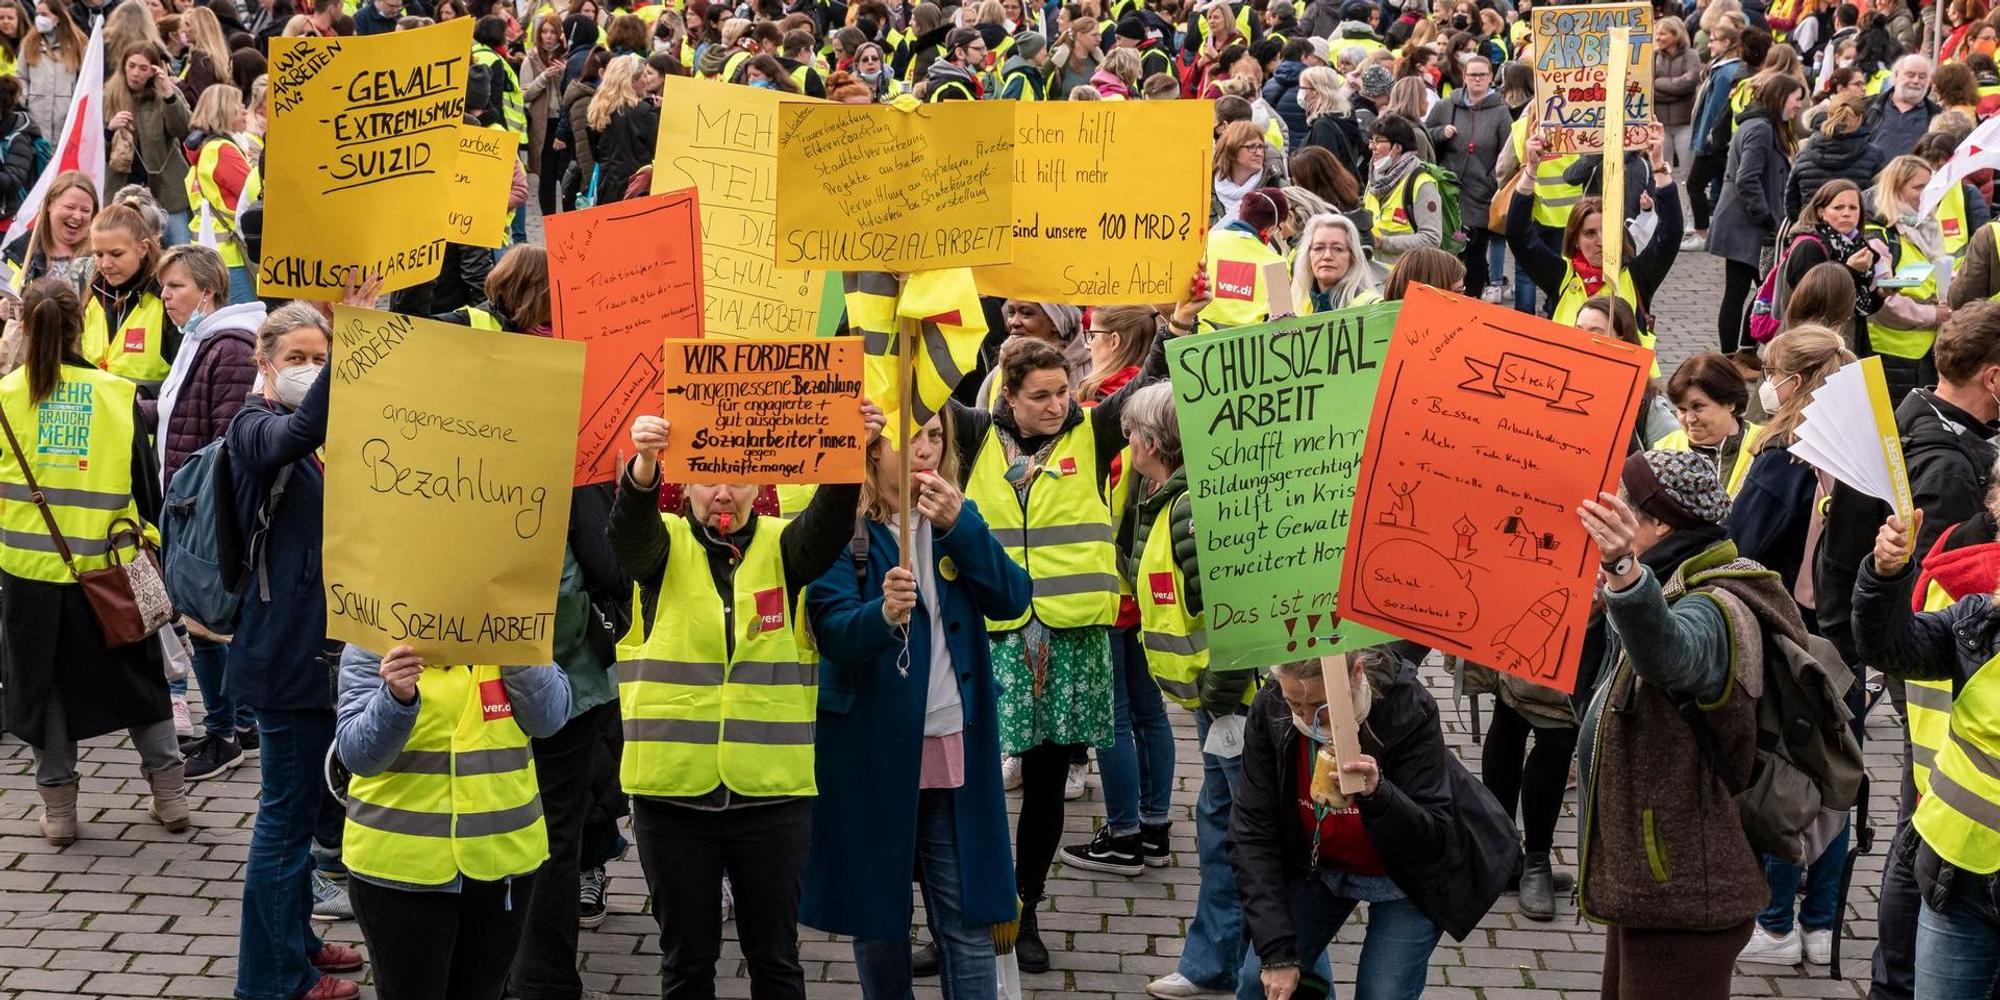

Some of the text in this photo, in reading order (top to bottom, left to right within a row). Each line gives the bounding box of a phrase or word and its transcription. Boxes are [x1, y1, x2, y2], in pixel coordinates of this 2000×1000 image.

[1539, 8, 1647, 36] SOZIALE
[274, 40, 316, 72] WIR
[1537, 34, 1653, 71] ARBET
[273, 40, 342, 99] ARBEITEN
[274, 90, 304, 118] AN:
[1544, 94, 1650, 128] Respkt
[1078, 111, 1116, 162] hilft
[1037, 159, 1066, 192] hilft
[1076, 160, 1109, 184] mehr
[1012, 213, 1039, 238] sind
[1046, 226, 1088, 240] unsere
[1098, 212, 1126, 240] 100
[786, 225, 1012, 263] SCHULSOZIALARBEIT
[1062, 260, 1173, 296] Soziale Arbeit
[1217, 281, 1252, 298] ver.di
[337, 318, 371, 349] WIR
[1405, 328, 1429, 346] Wir
[336, 314, 416, 385] FORDERN!
[684, 344, 727, 373] WIR
[685, 374, 862, 406] angemessene Bezahlung
[1502, 362, 1556, 392] Streik
[38, 410, 92, 427] BRAUCHT
[716, 399, 739, 416] für
[744, 400, 812, 415] engagierte
[1208, 384, 1325, 436] ARBEIT
[38, 425, 90, 449] MEHR
[383, 404, 518, 443] angemessene
[715, 412, 830, 435] gut ausgebildete
[1294, 424, 1364, 454] mehr
[1421, 428, 1456, 450] Mehr
[743, 449, 777, 461] gegen
[362, 438, 547, 539] Bezahlung
[1218, 495, 1274, 522] hilft
[1286, 491, 1305, 507] in
[1207, 509, 1349, 555] beugt Gewalt
[1209, 546, 1308, 581] erweitert
[1153, 592, 1174, 601] ver.di
[1213, 602, 1259, 631] Das
[1270, 589, 1304, 619] ist
